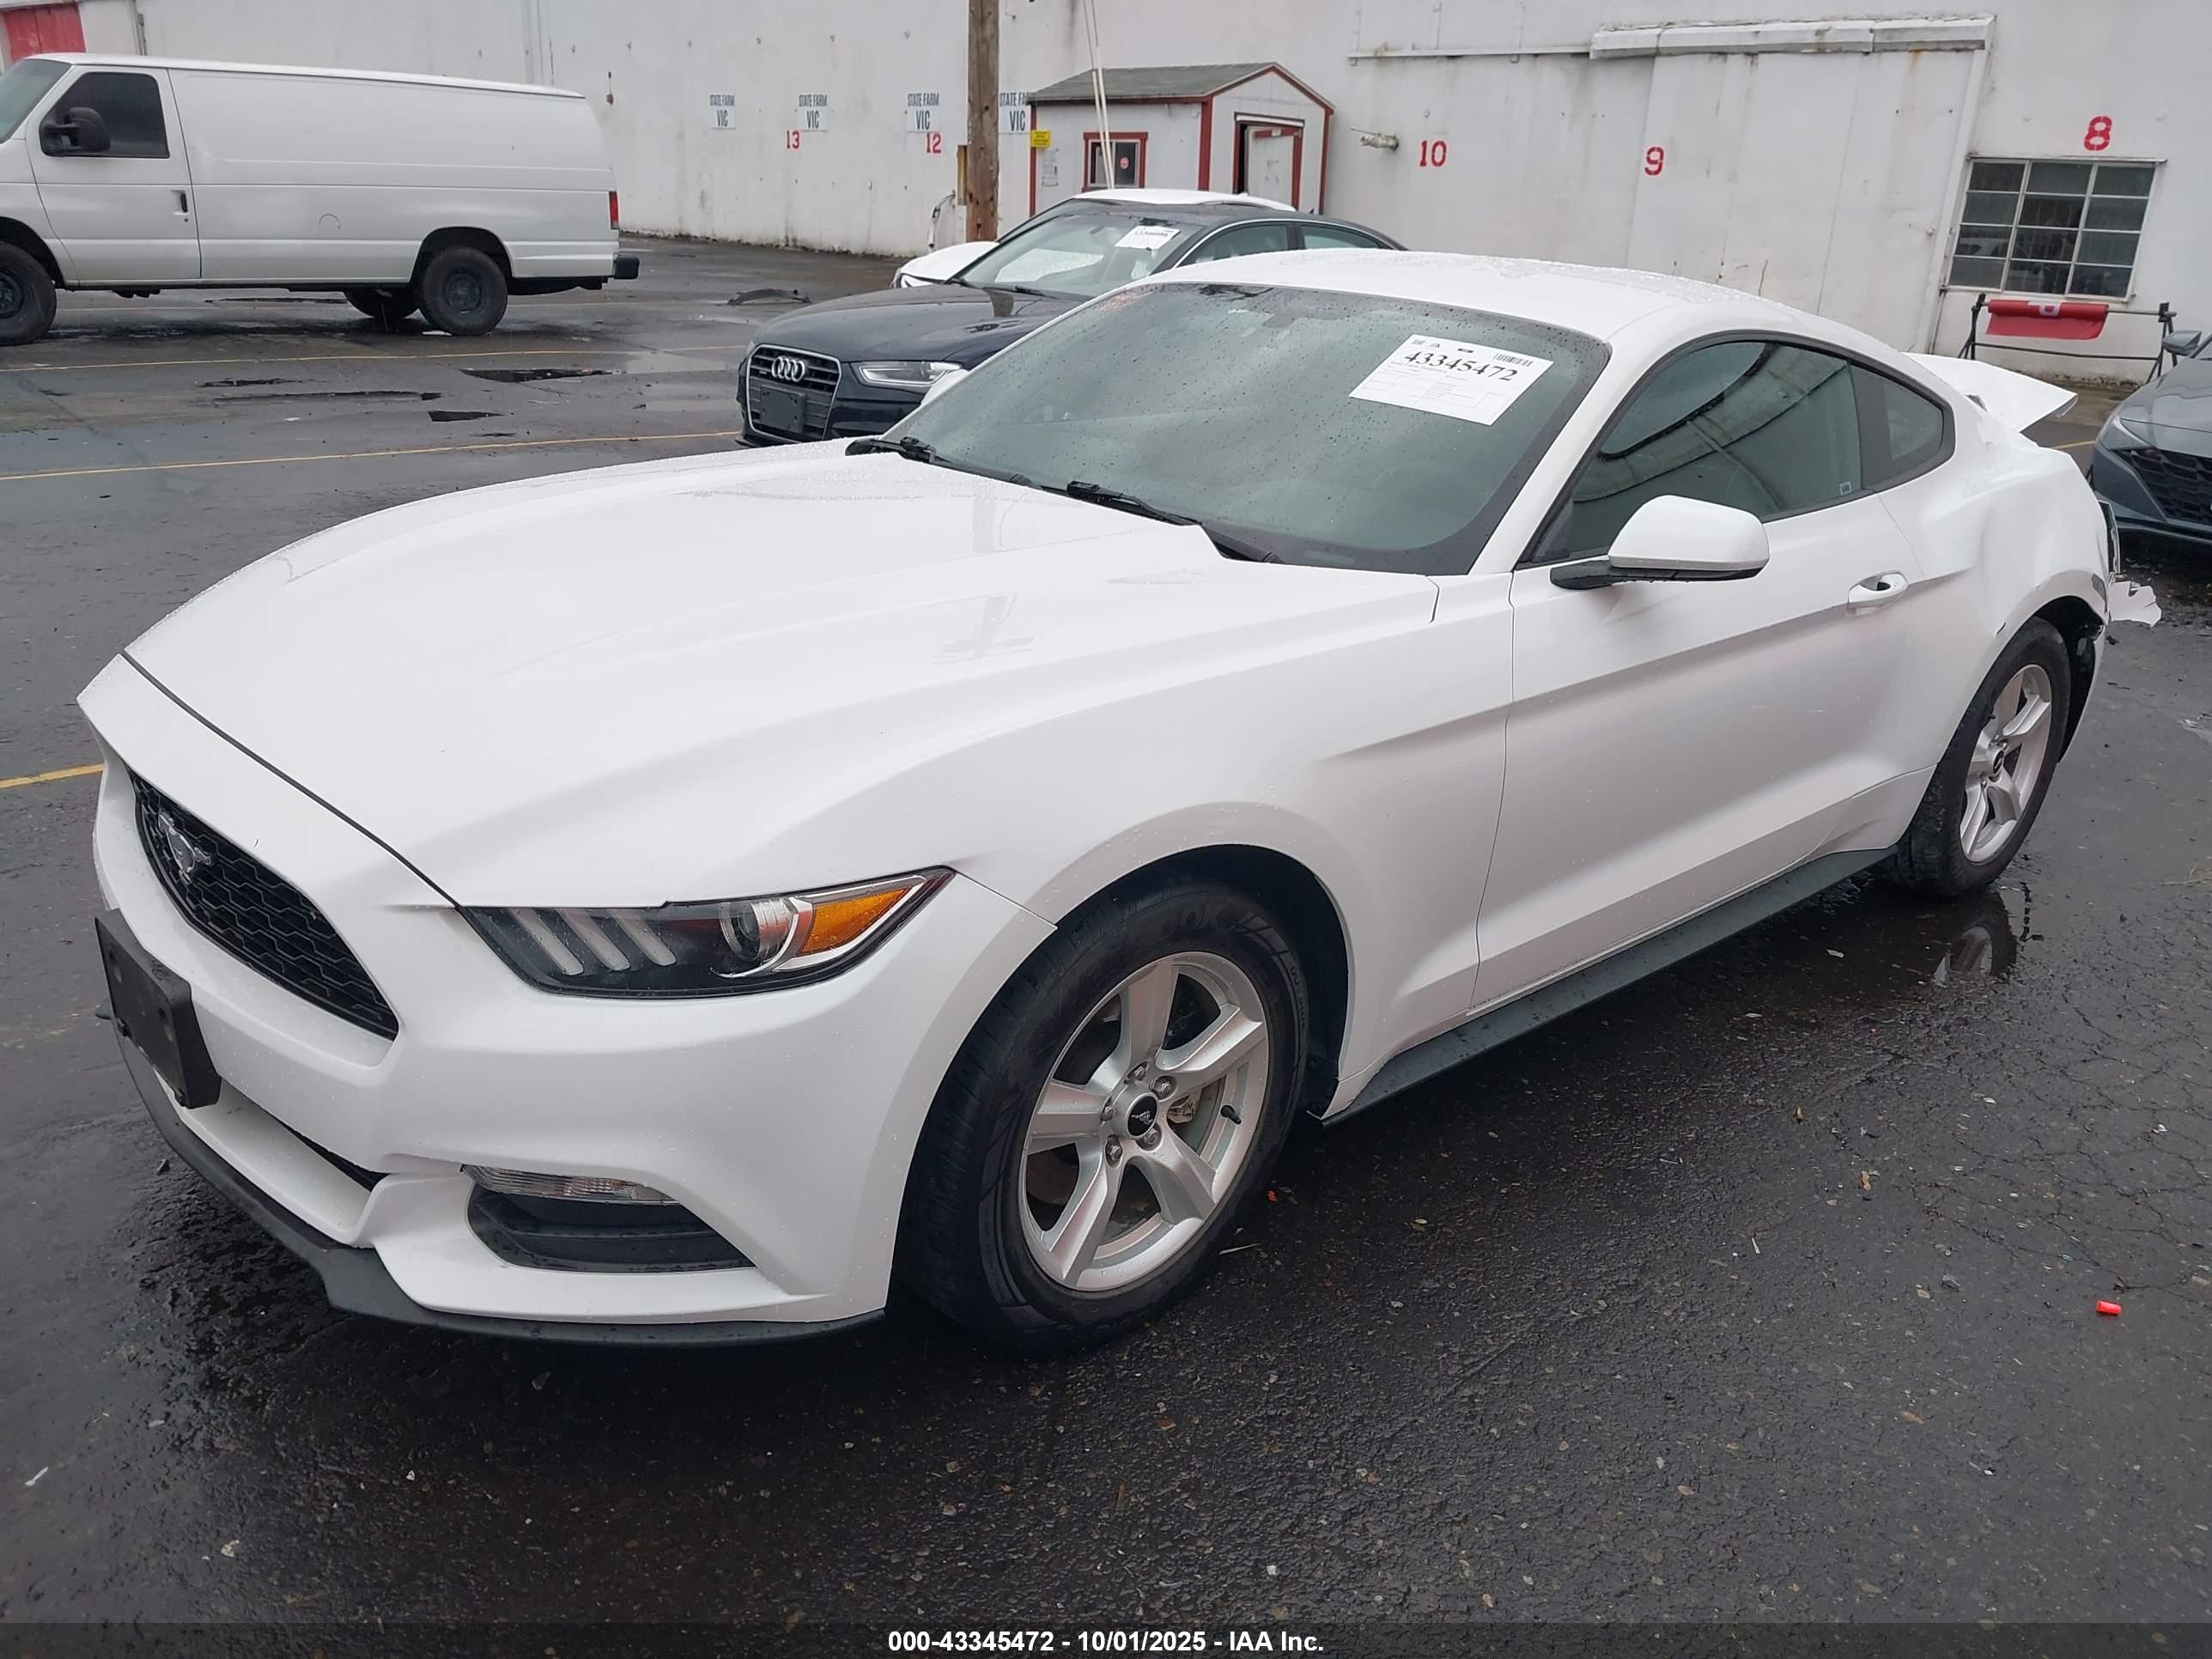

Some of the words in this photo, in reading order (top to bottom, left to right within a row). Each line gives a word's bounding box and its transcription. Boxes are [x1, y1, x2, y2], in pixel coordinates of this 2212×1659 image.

[709, 94, 722, 106] STATE
[722, 94, 735, 106] FARM
[799, 94, 812, 107] STATE
[813, 94, 828, 106] FARM
[908, 93, 922, 106] STATE
[923, 93, 939, 106] FARM
[1000, 92, 1017, 106] STATE
[716, 109, 728, 127] VIC
[806, 110, 819, 129] VIC
[915, 110, 931, 131] VIC
[1010, 110, 1025, 131] VIC
[787, 131, 800, 149] 13
[927, 132, 942, 154] 12
[2084, 115, 2112, 151] 8
[1419, 140, 1447, 167] 10
[1644, 146, 1664, 176] 9
[1404, 350, 1518, 381] 43345472
